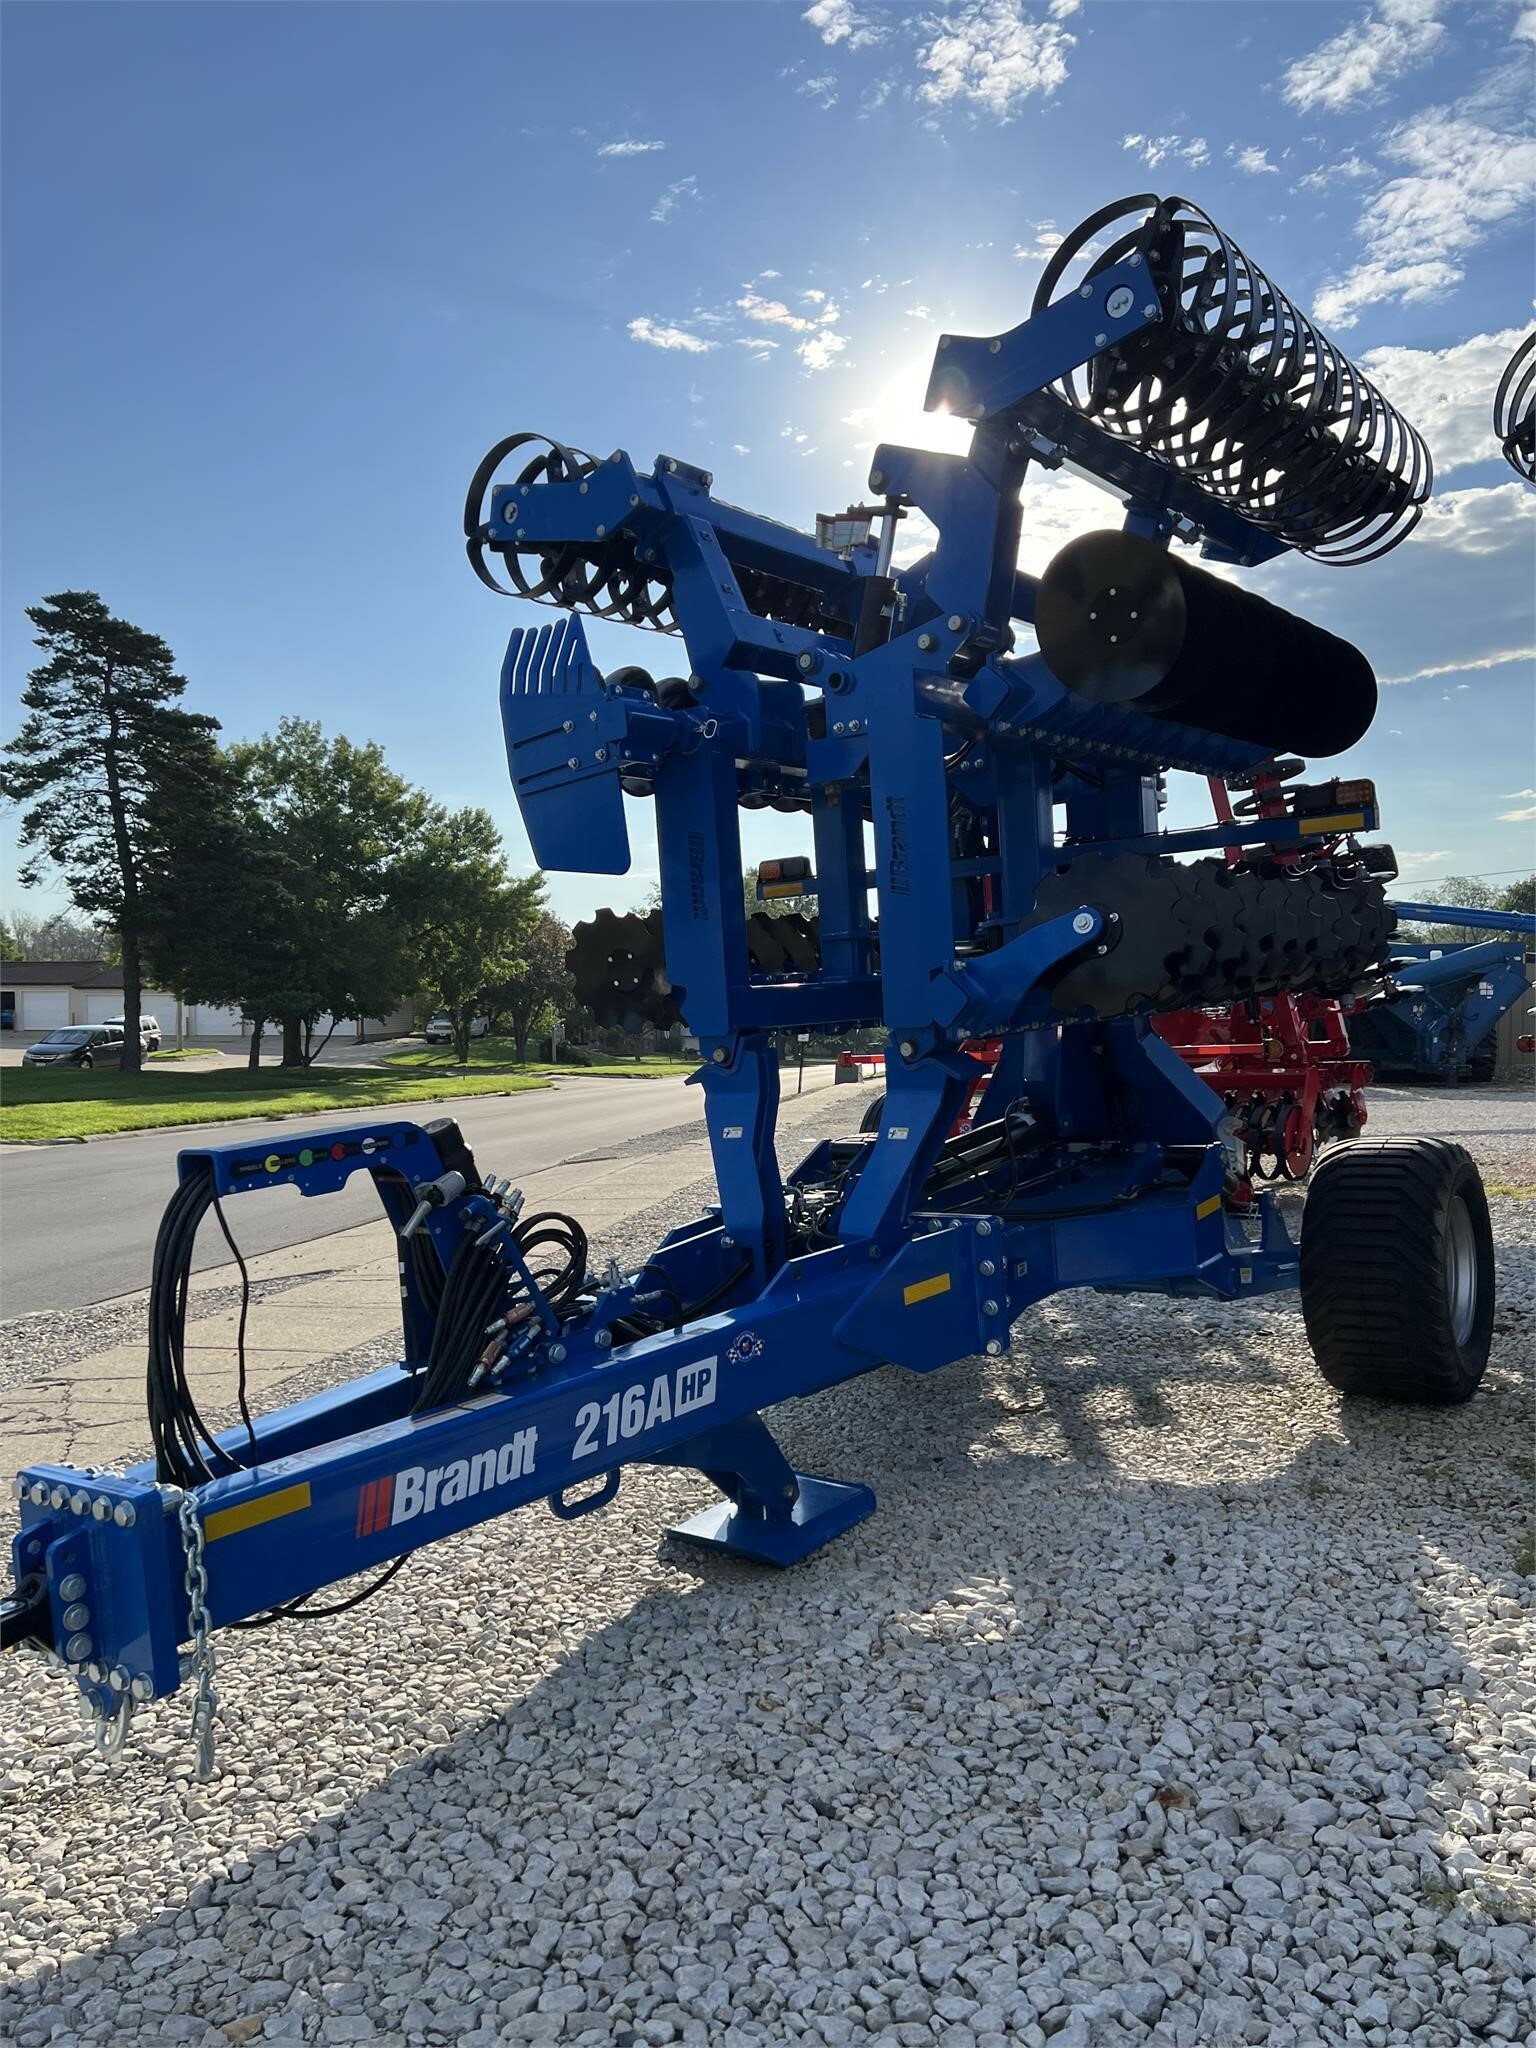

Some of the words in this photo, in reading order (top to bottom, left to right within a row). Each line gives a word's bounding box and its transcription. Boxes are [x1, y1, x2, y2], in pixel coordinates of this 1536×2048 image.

[886, 796, 909, 876] Brandt
[571, 1374, 671, 1460] 216A
[391, 1425, 538, 1526] Brandt
